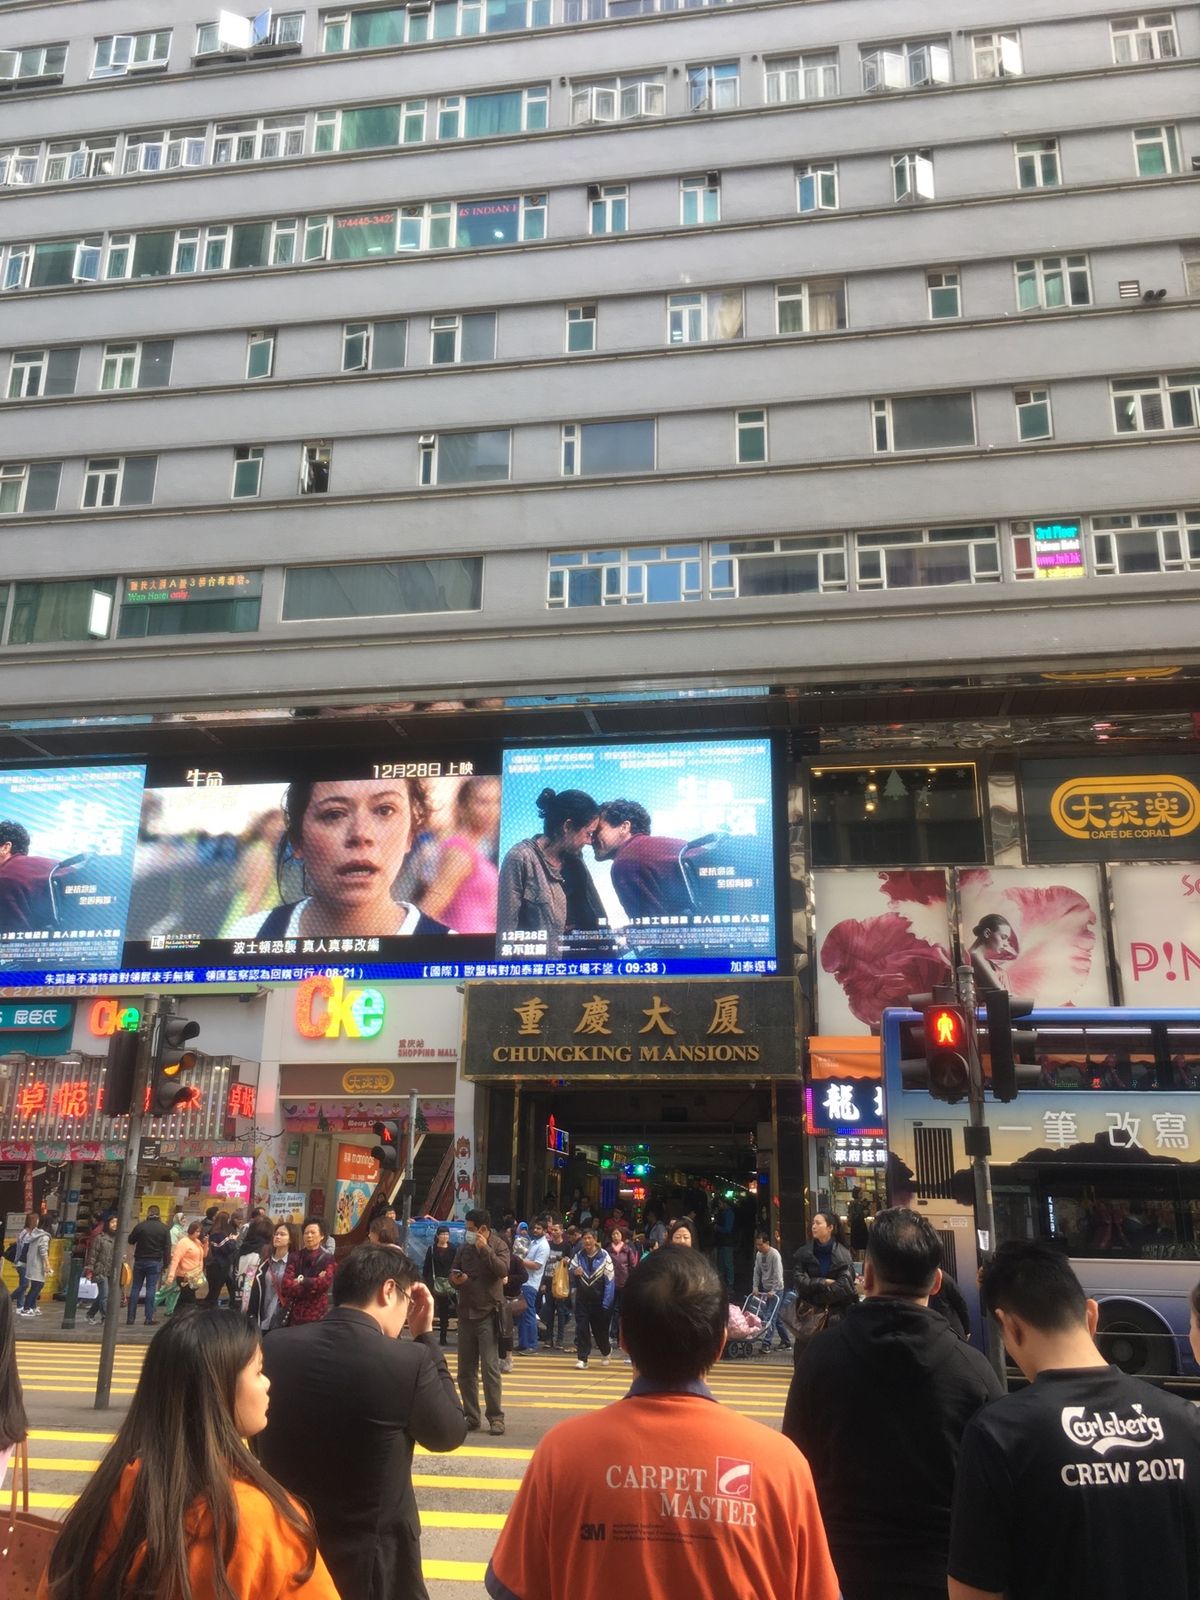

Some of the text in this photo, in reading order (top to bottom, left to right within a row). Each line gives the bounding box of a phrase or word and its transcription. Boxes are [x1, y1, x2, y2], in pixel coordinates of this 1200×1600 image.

[472, 204, 510, 216] INDIAN
[373, 761, 474, 779] 12月28日 上映
[1119, 830, 1134, 839] DE
[1134, 828, 1169, 839] CORAL
[502, 930, 548, 942] 12月28日
[14, 984, 99, 997] 27230020
[296, 976, 386, 1039] Cke
[14, 1009, 58, 1025] 屈臣氏
[397, 1048, 458, 1057] SHOPPING MALL
[492, 1044, 760, 1064] CHUNGKING MANSIONS
[1061, 1403, 1165, 1454] Carlsberg
[605, 1464, 707, 1493] CARPET
[1060, 1458, 1185, 1487] CREW 2017
[660, 1491, 758, 1528] MASTER
[581, 1522, 606, 1541] 3M
